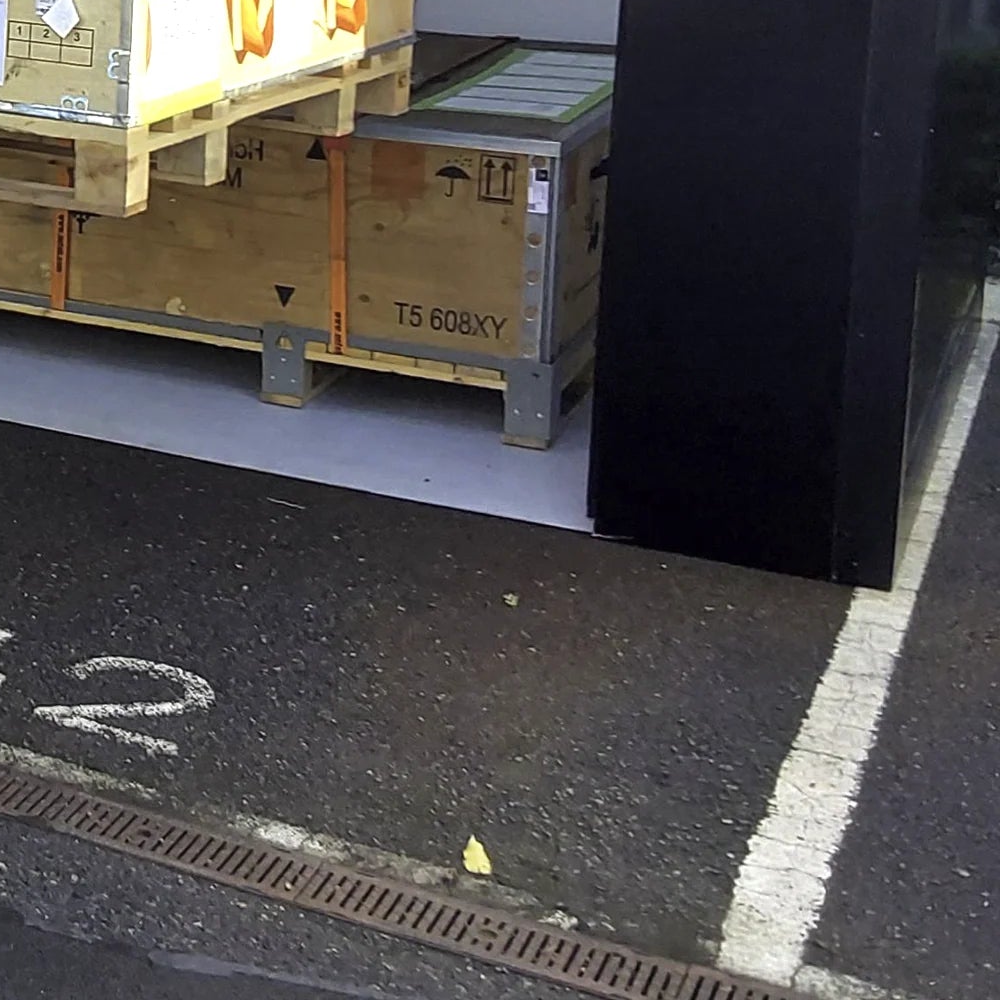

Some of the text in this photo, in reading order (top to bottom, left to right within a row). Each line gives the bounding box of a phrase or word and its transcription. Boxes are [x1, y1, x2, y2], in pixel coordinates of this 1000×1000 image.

[17, 25, 81, 42] 1 2 3
[394, 301, 508, 340] T5 608XY
